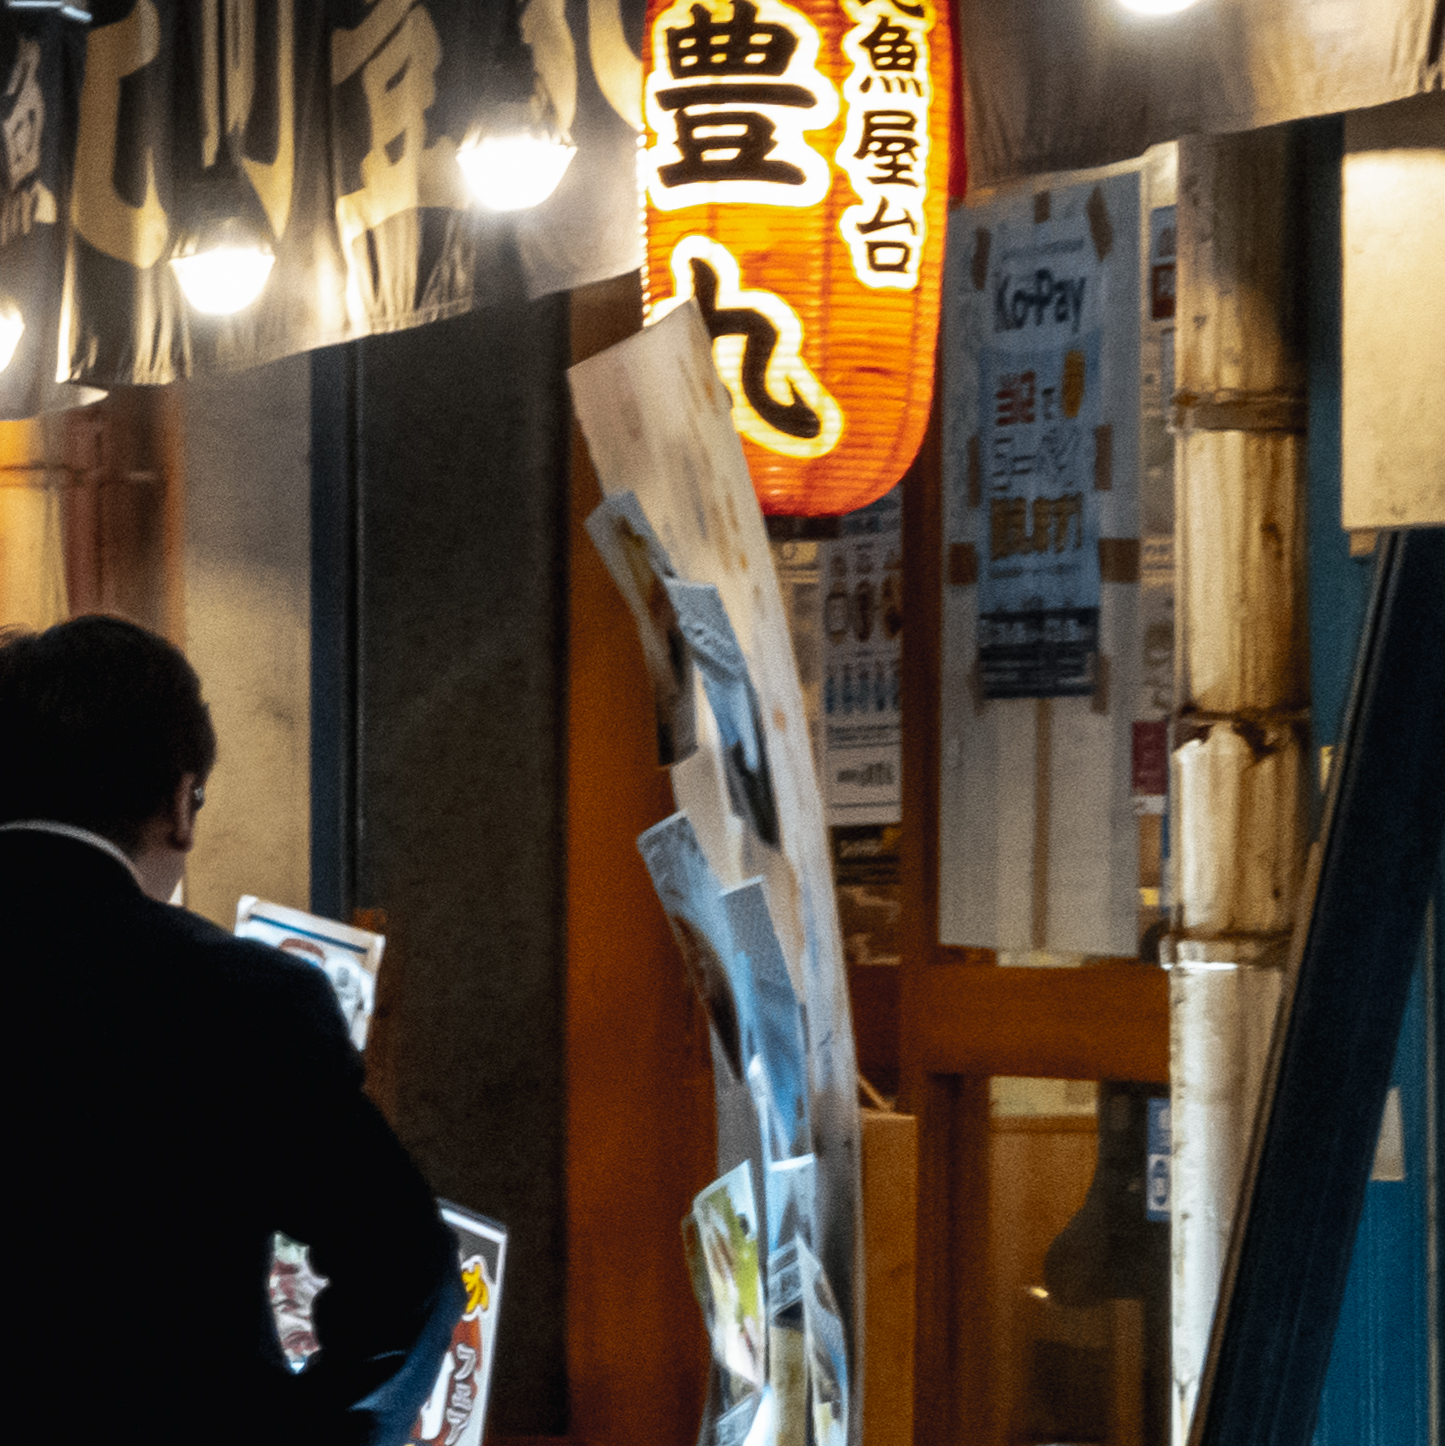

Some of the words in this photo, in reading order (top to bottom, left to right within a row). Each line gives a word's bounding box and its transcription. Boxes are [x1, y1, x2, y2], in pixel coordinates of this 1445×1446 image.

[654, 0, 820, 439] 豊丸
[853, 0, 926, 274] 魚屋台
